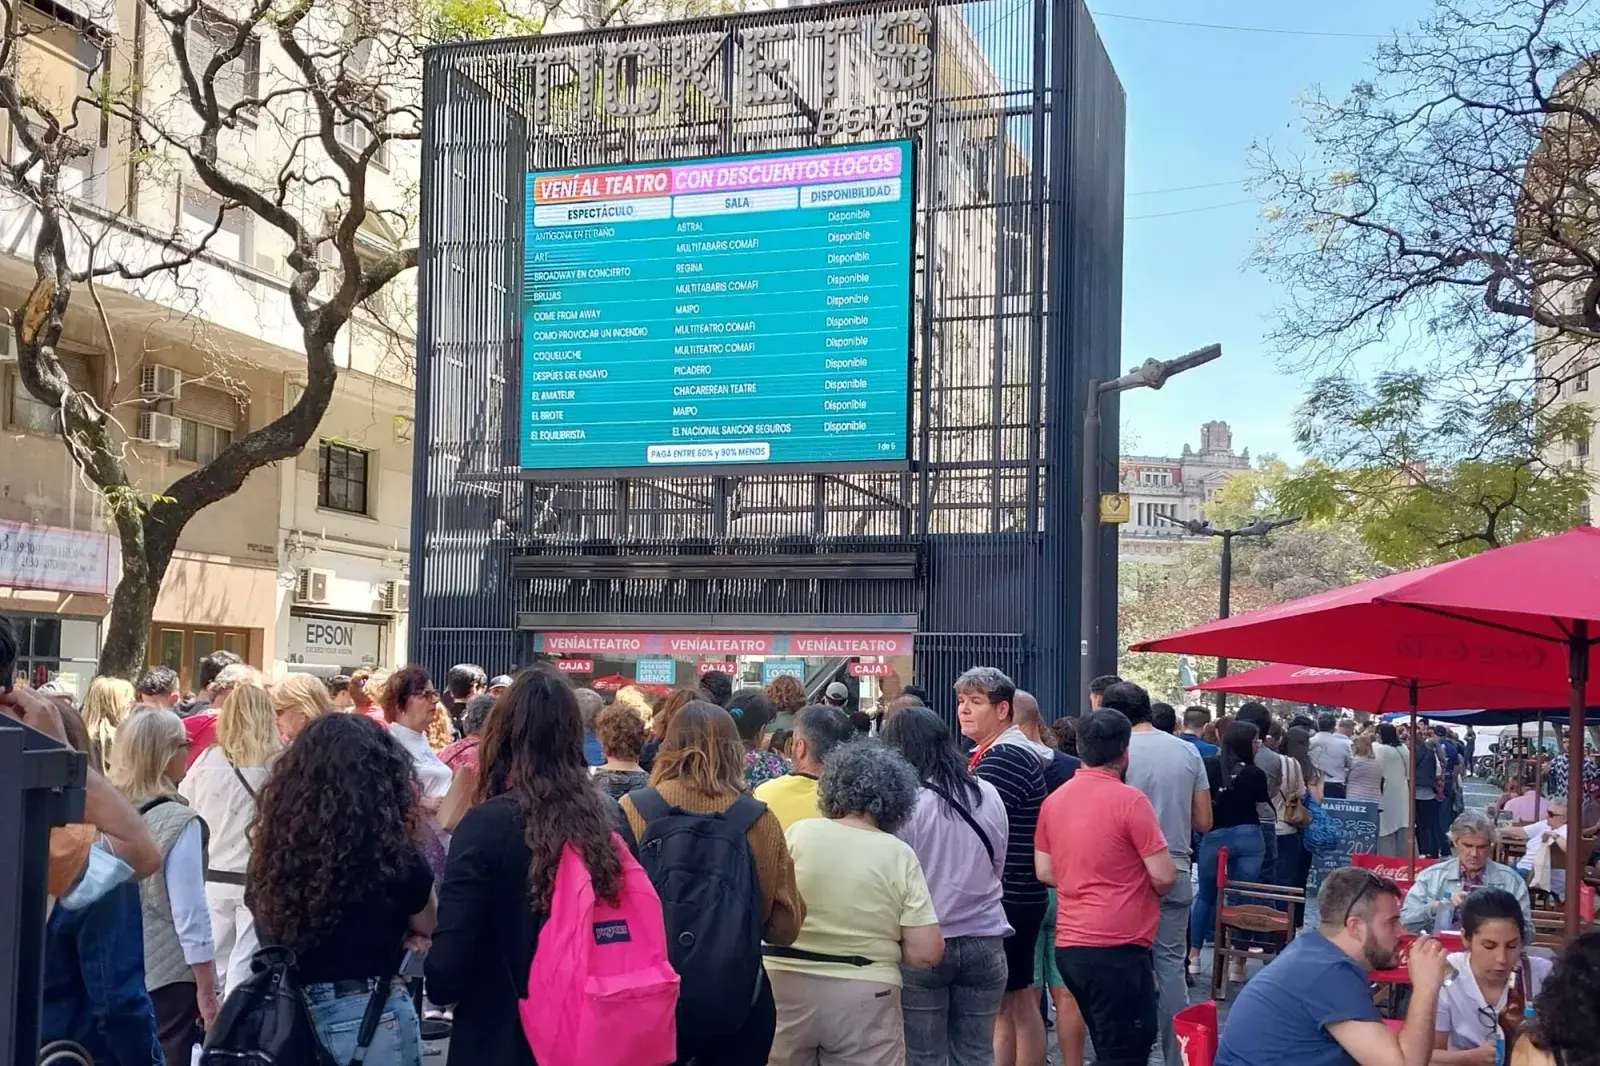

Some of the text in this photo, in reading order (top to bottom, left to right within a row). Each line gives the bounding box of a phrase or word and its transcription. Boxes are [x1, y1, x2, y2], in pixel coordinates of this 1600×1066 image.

[518, 9, 933, 126] TICKETS
[540, 152, 895, 199] VENÍ AL TEATRO CON DESCUENTOS LOCOS
[811, 185, 891, 203] DISPONIBILIDAD
[724, 197, 750, 209] SALA
[567, 204, 634, 220] ESPECTÁCULO
[828, 210, 870, 222] Disponible
[677, 222, 703, 232] ASTRAL
[574, 230, 583, 239] EN
[828, 230, 870, 243] Disponible
[676, 239, 759, 252] MULTITABARIS COMAFI
[827, 252, 869, 264] Disponible
[676, 262, 703, 272] REGINA
[534, 267, 631, 282] BROADWAY EN CONCIERTO
[827, 273, 869, 286] Disponible
[676, 280, 759, 294] MULTITABARIS COMAFI
[534, 291, 562, 301] BRUJAS
[826, 295, 869, 307] Disponible
[534, 309, 601, 321] COME FROM AWAY
[675, 304, 700, 314] MAIPO
[674, 321, 756, 334] MULTITEATRO COMAFI
[826, 316, 868, 328] Disponible
[534, 327, 648, 341] COMO PROVOCAR UN INCENDIO
[826, 336, 868, 348] Disponible
[674, 342, 755, 355] MULTITEATRO COMAFI
[533, 350, 582, 361] COQUELUCHE
[674, 364, 711, 375] PICADERO
[825, 357, 867, 370] Disponible
[564, 370, 577, 379] DEL
[578, 369, 608, 379] ENSAYO
[673, 383, 757, 396] CHACAREREAN TEATRE
[825, 378, 867, 391] Disponible
[532, 390, 575, 400] EL AMATEUR
[672, 406, 698, 416] MAIPO
[824, 399, 867, 412] Disponible
[532, 410, 564, 420] EL BROTE
[672, 422, 792, 437] EL NACIONAL SANCOR SEGUROS
[824, 421, 867, 433] Disponible
[531, 430, 586, 441] EL EQUILIBRISTA
[673, 449, 695, 458] ENTRE
[697, 447, 713, 457] 60%
[721, 447, 737, 457] 90%
[738, 446, 766, 457] MENOS
[306, 623, 353, 646] EPSON
[558, 661, 591, 671] CAJA 3
[728, 663, 735, 672] 2
[854, 665, 888, 674] CAJA 1
[640, 674, 671, 682] MENOS
